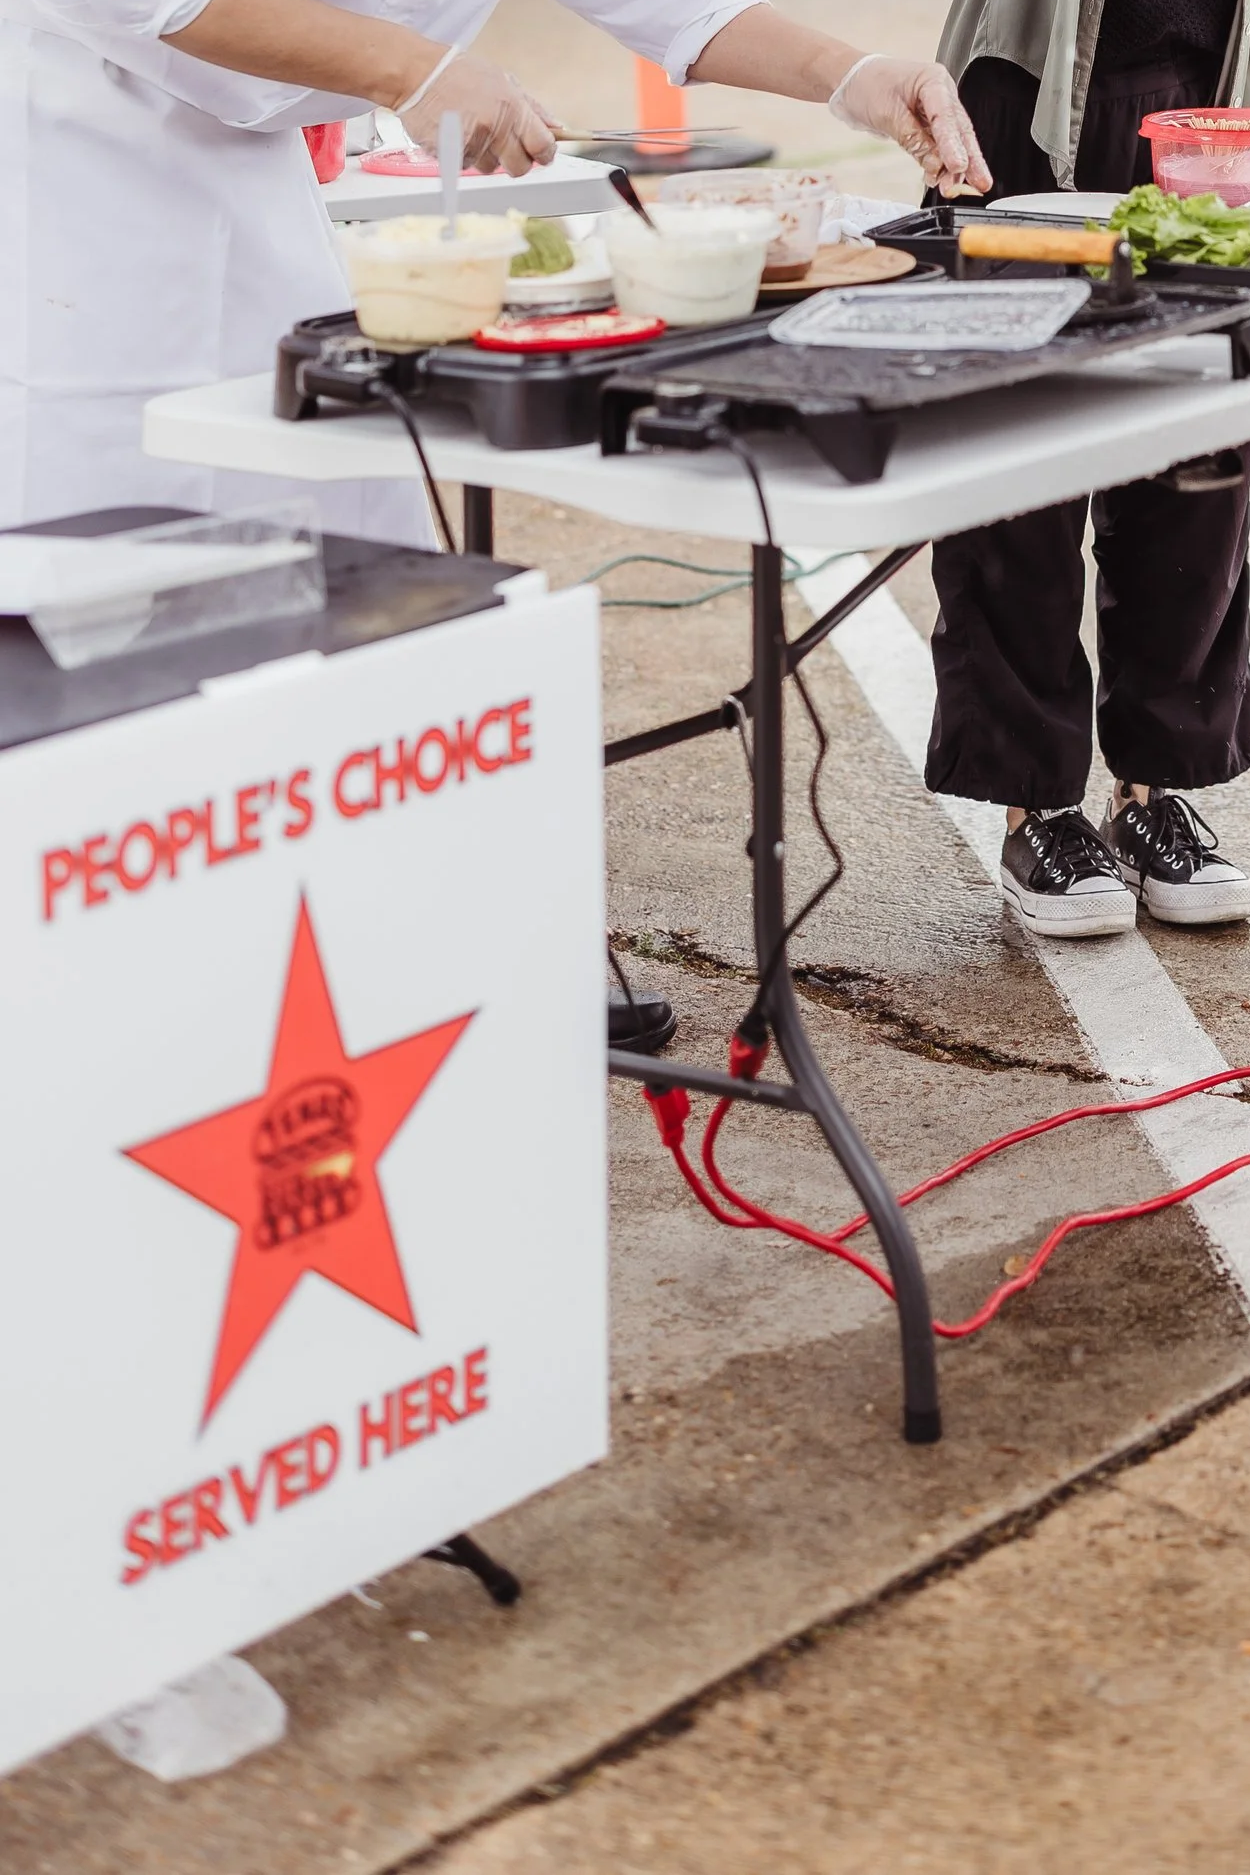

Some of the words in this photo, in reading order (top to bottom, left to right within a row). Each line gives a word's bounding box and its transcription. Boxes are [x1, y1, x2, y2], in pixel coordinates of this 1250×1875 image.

[41, 768, 314, 921] PEOPLE'S
[332, 697, 533, 820] CHOICE
[121, 1424, 341, 1585] SERVED
[359, 1348, 489, 1468] HERE
